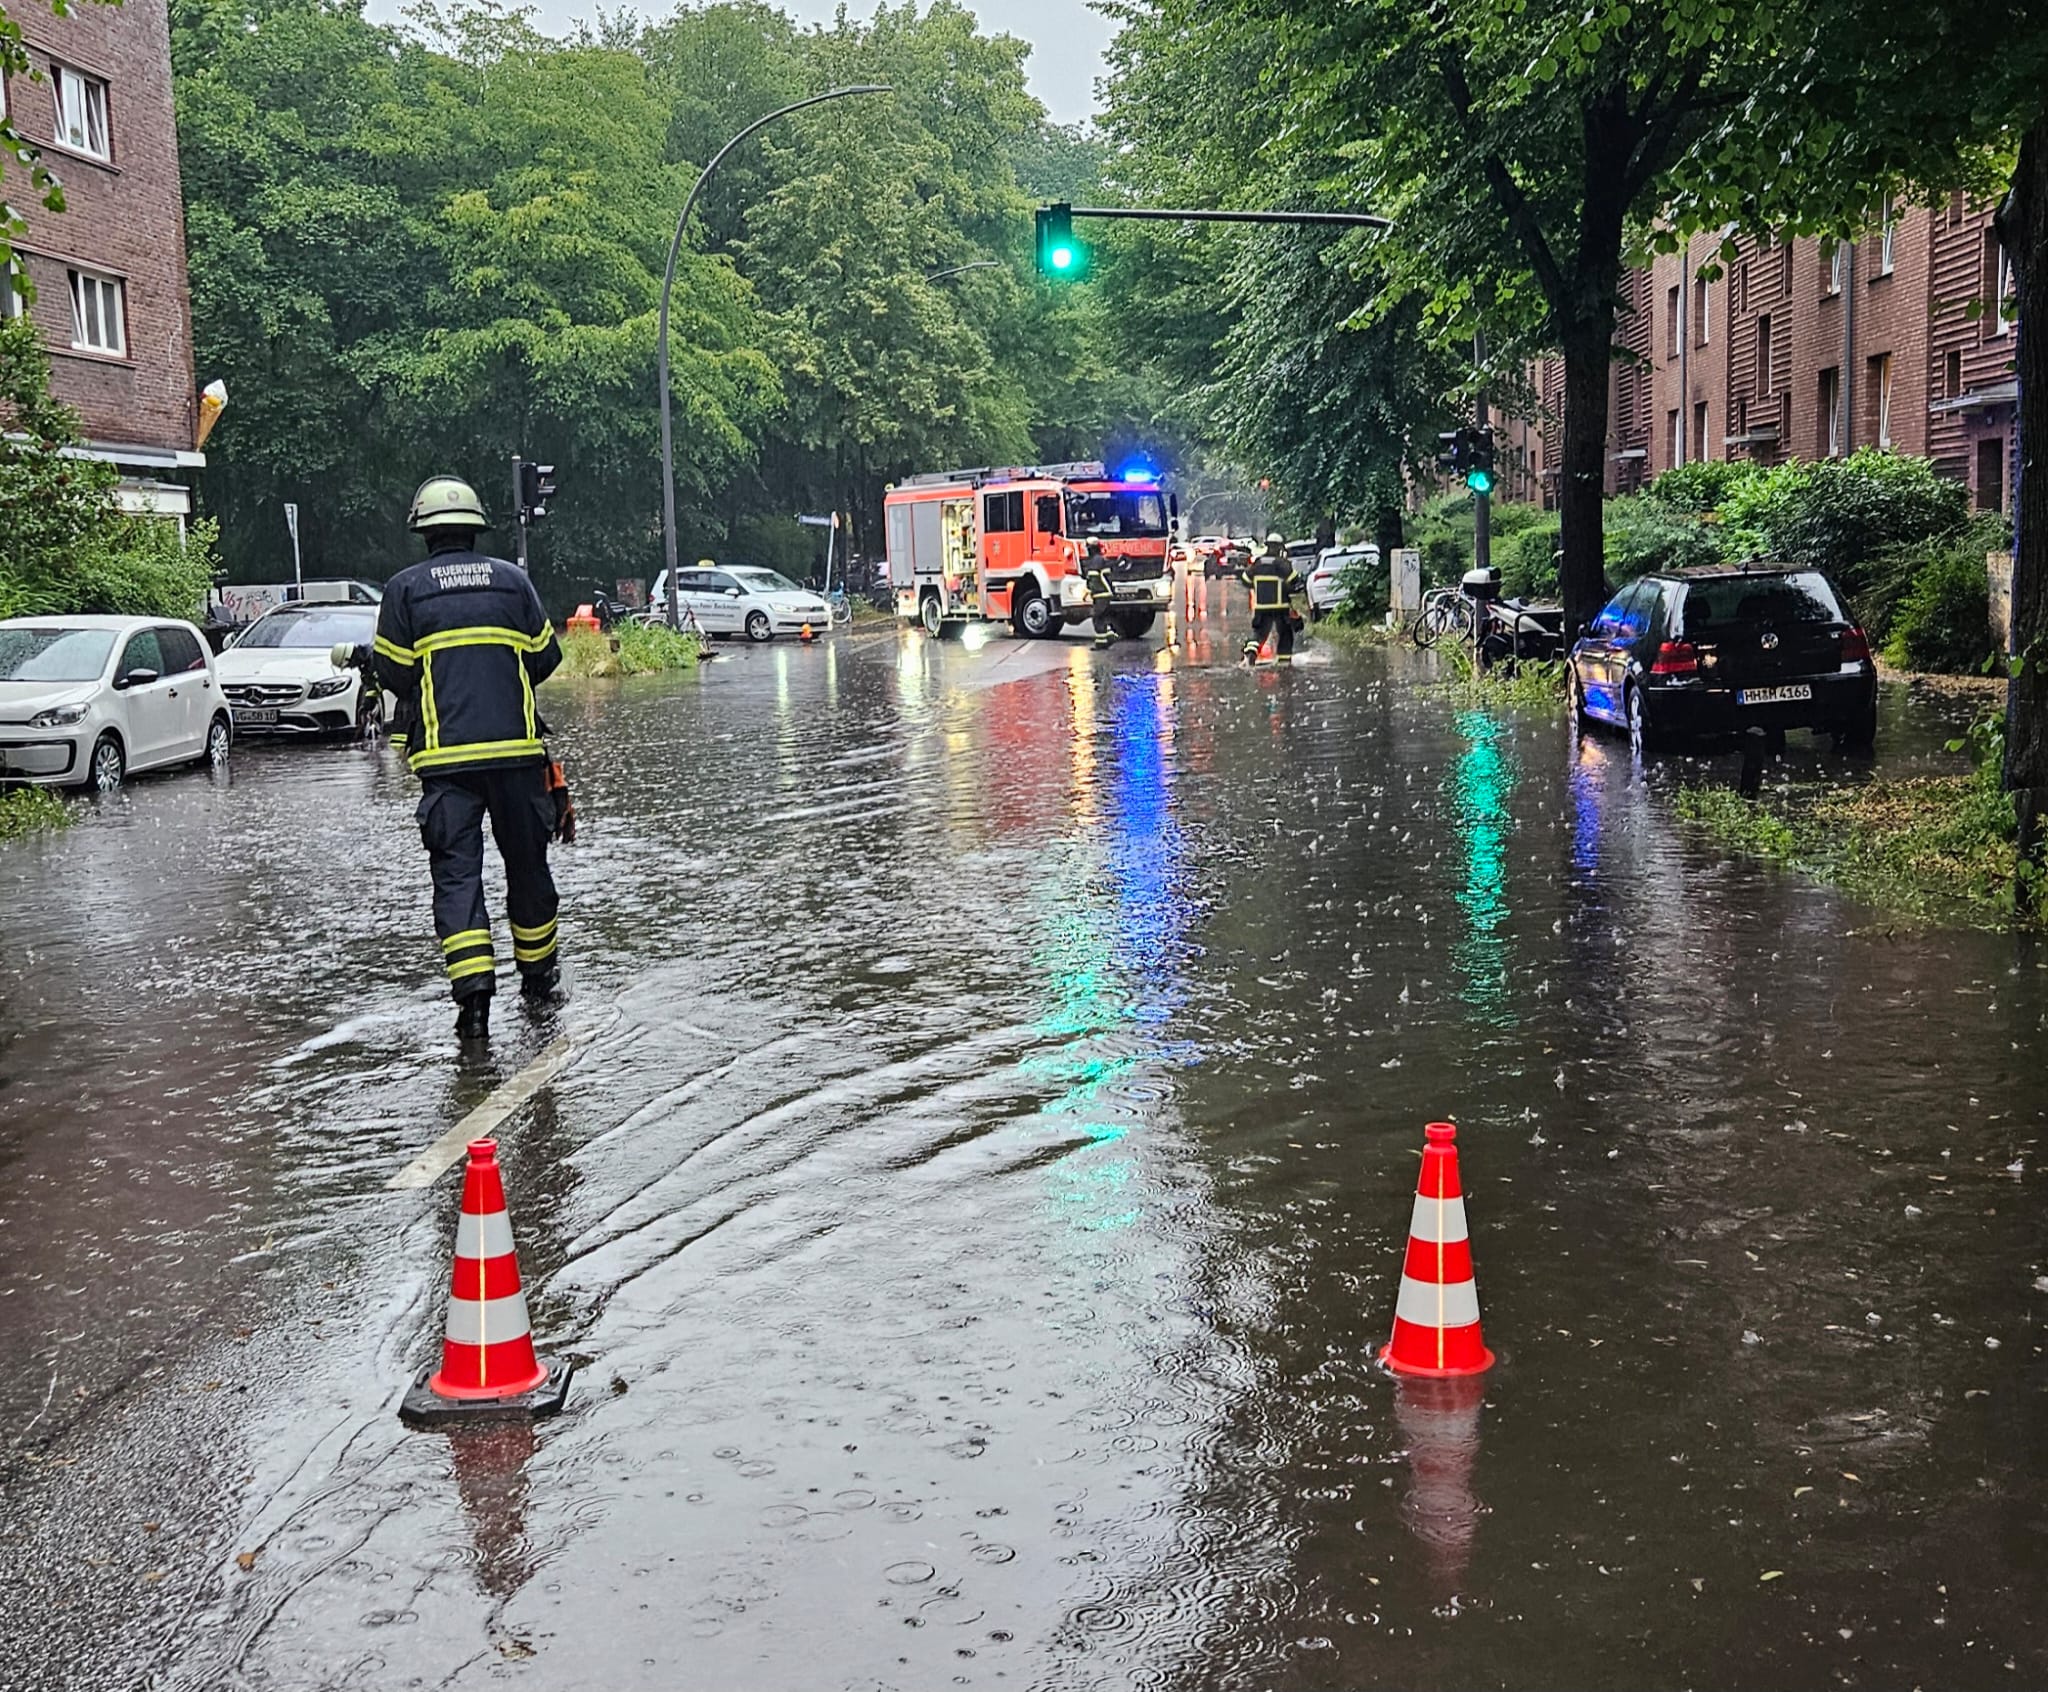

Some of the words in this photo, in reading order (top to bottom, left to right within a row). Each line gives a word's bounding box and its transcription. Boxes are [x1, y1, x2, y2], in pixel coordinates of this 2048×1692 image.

[430, 562, 493, 579] FEUERWEHR
[440, 573, 490, 590] HAMBURG
[1779, 686, 1810, 699] 4166
